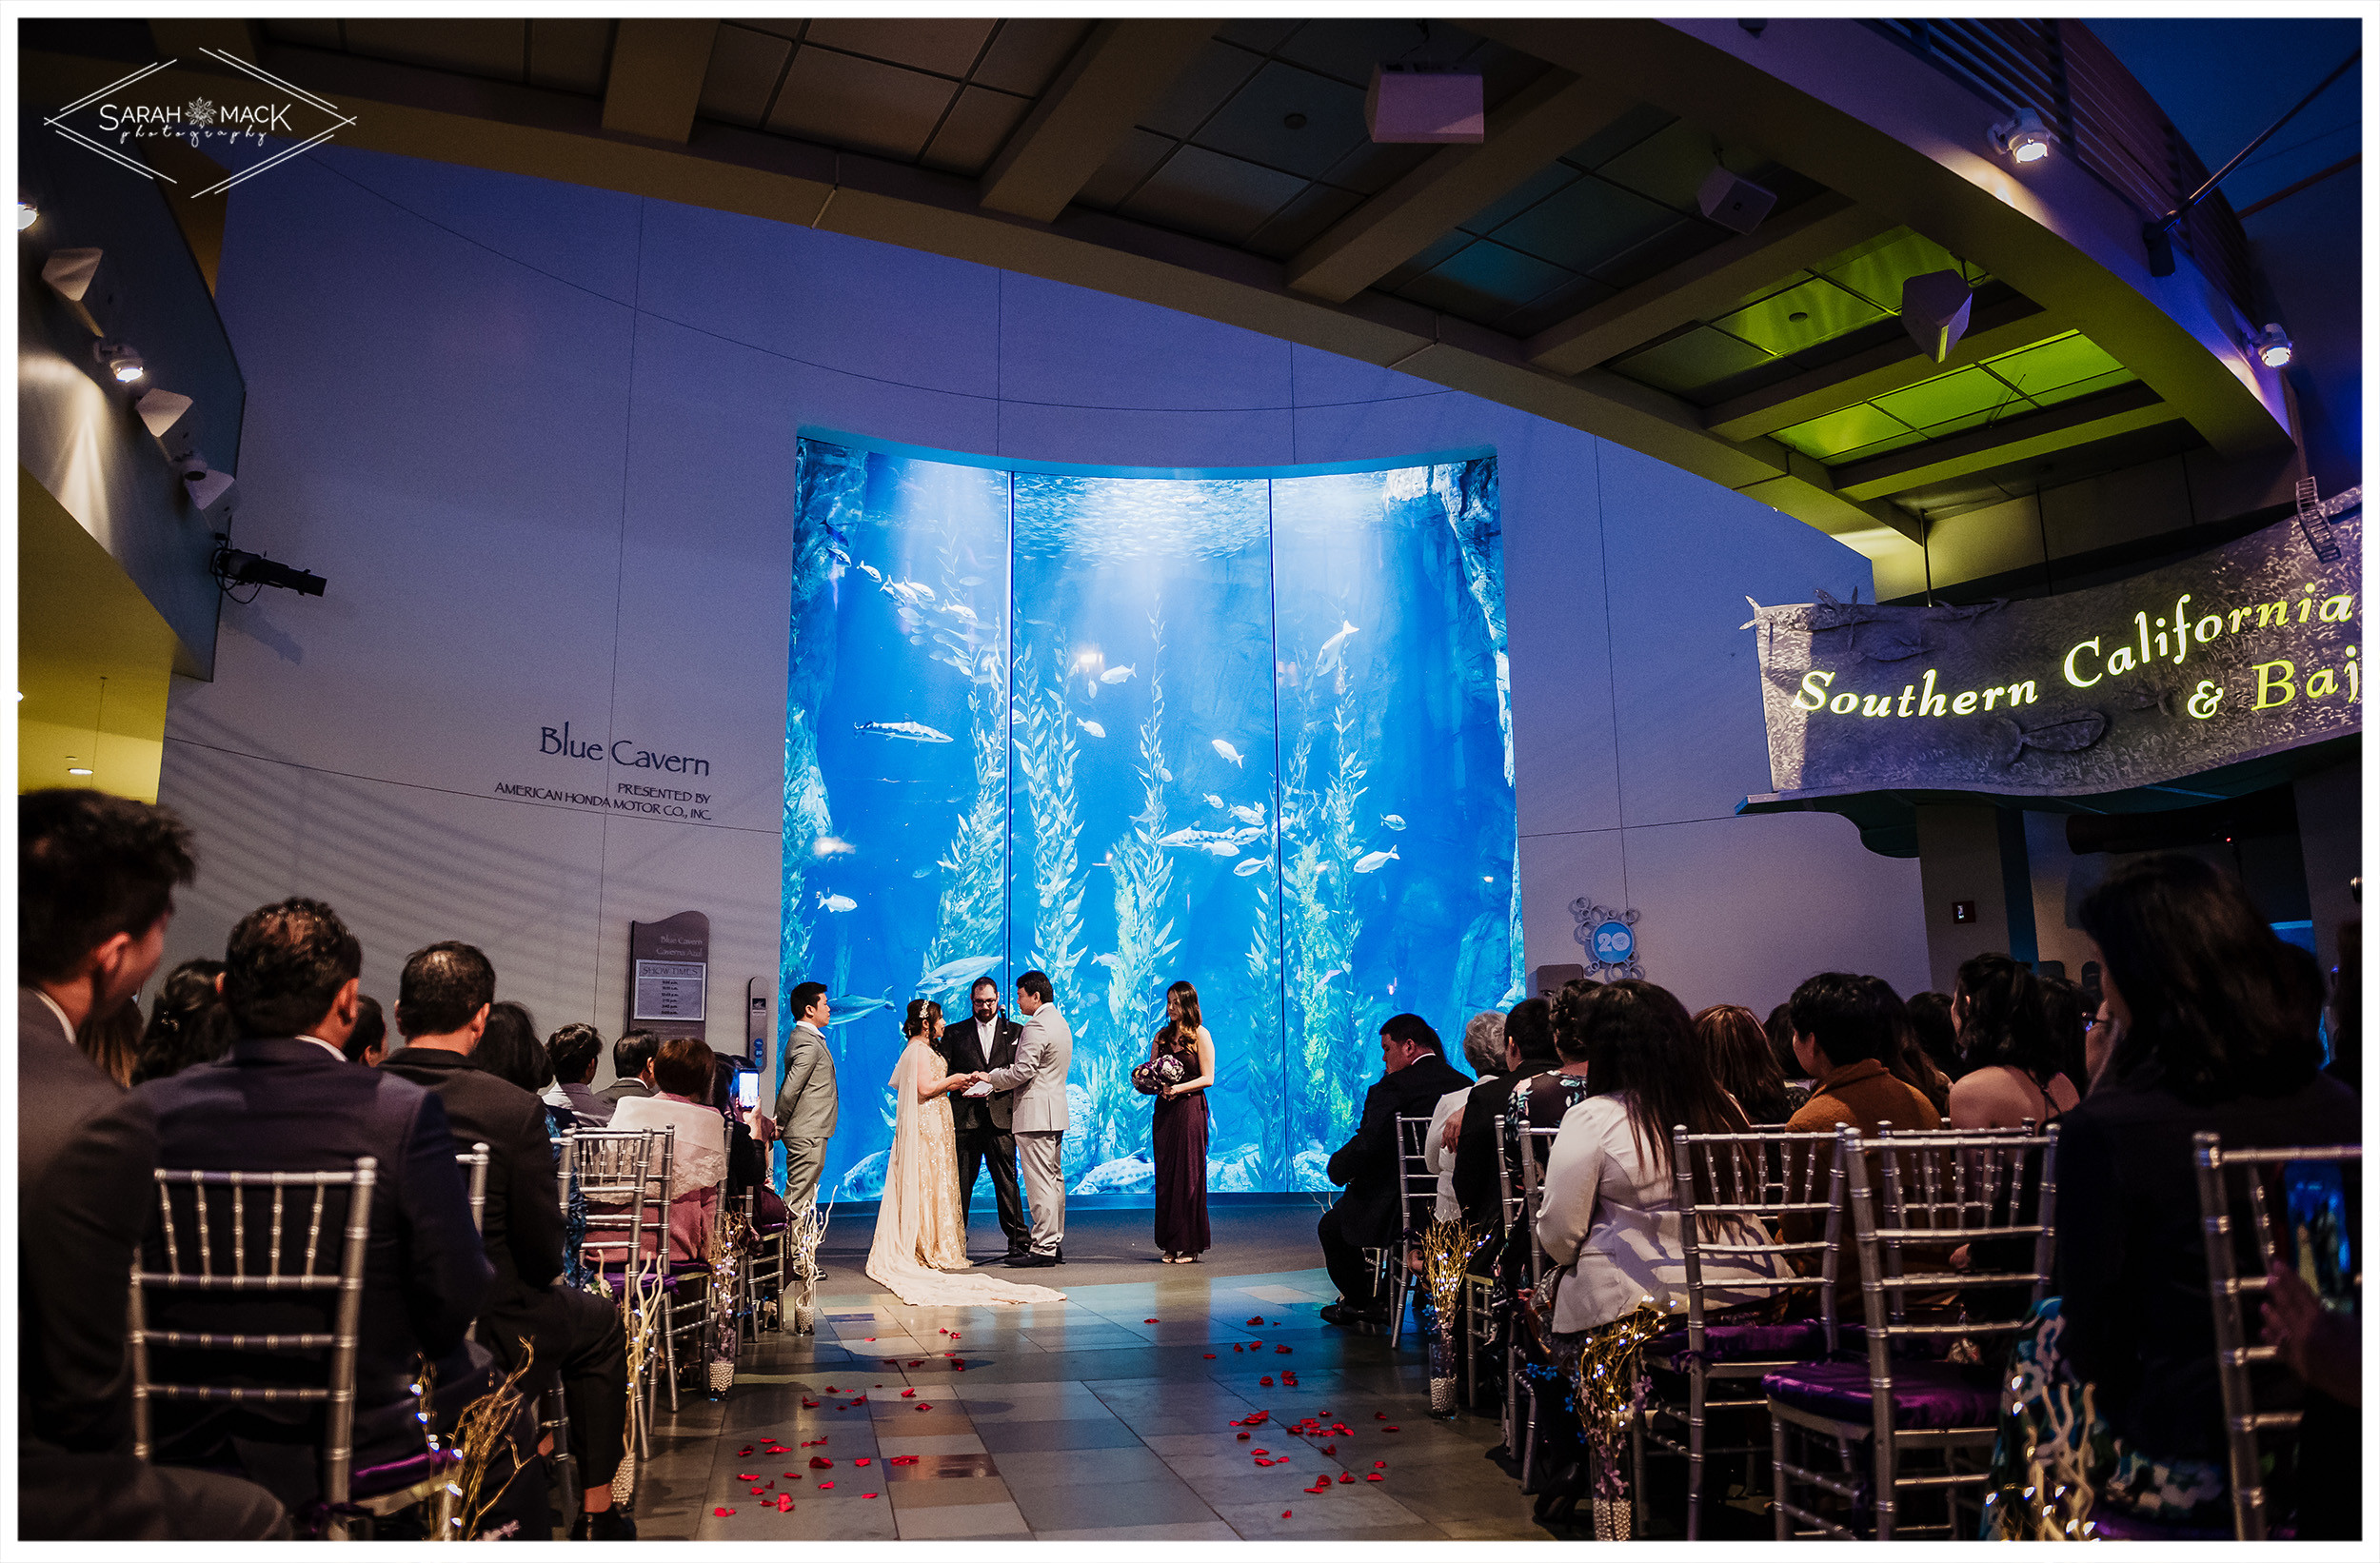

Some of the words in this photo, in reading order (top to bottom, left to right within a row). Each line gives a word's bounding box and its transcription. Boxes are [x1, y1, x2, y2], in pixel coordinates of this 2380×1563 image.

[1791, 668, 2038, 719] Southern
[2063, 582, 2353, 688] California
[2187, 679, 2224, 720] &
[539, 721, 604, 761] Blue
[611, 740, 710, 777] Cavern
[494, 782, 563, 802] AMERICAN
[565, 792, 611, 808] HONDA
[613, 799, 662, 815] MOTOR
[618, 782, 693, 801] PRESENTED
[695, 793, 712, 803] BY
[660, 934, 677, 944] Blue
[678, 936, 704, 945] Cavern
[1597, 931, 1631, 952] 20
[642, 966, 669, 975] SHOW
[671, 967, 698, 976] TIMES
